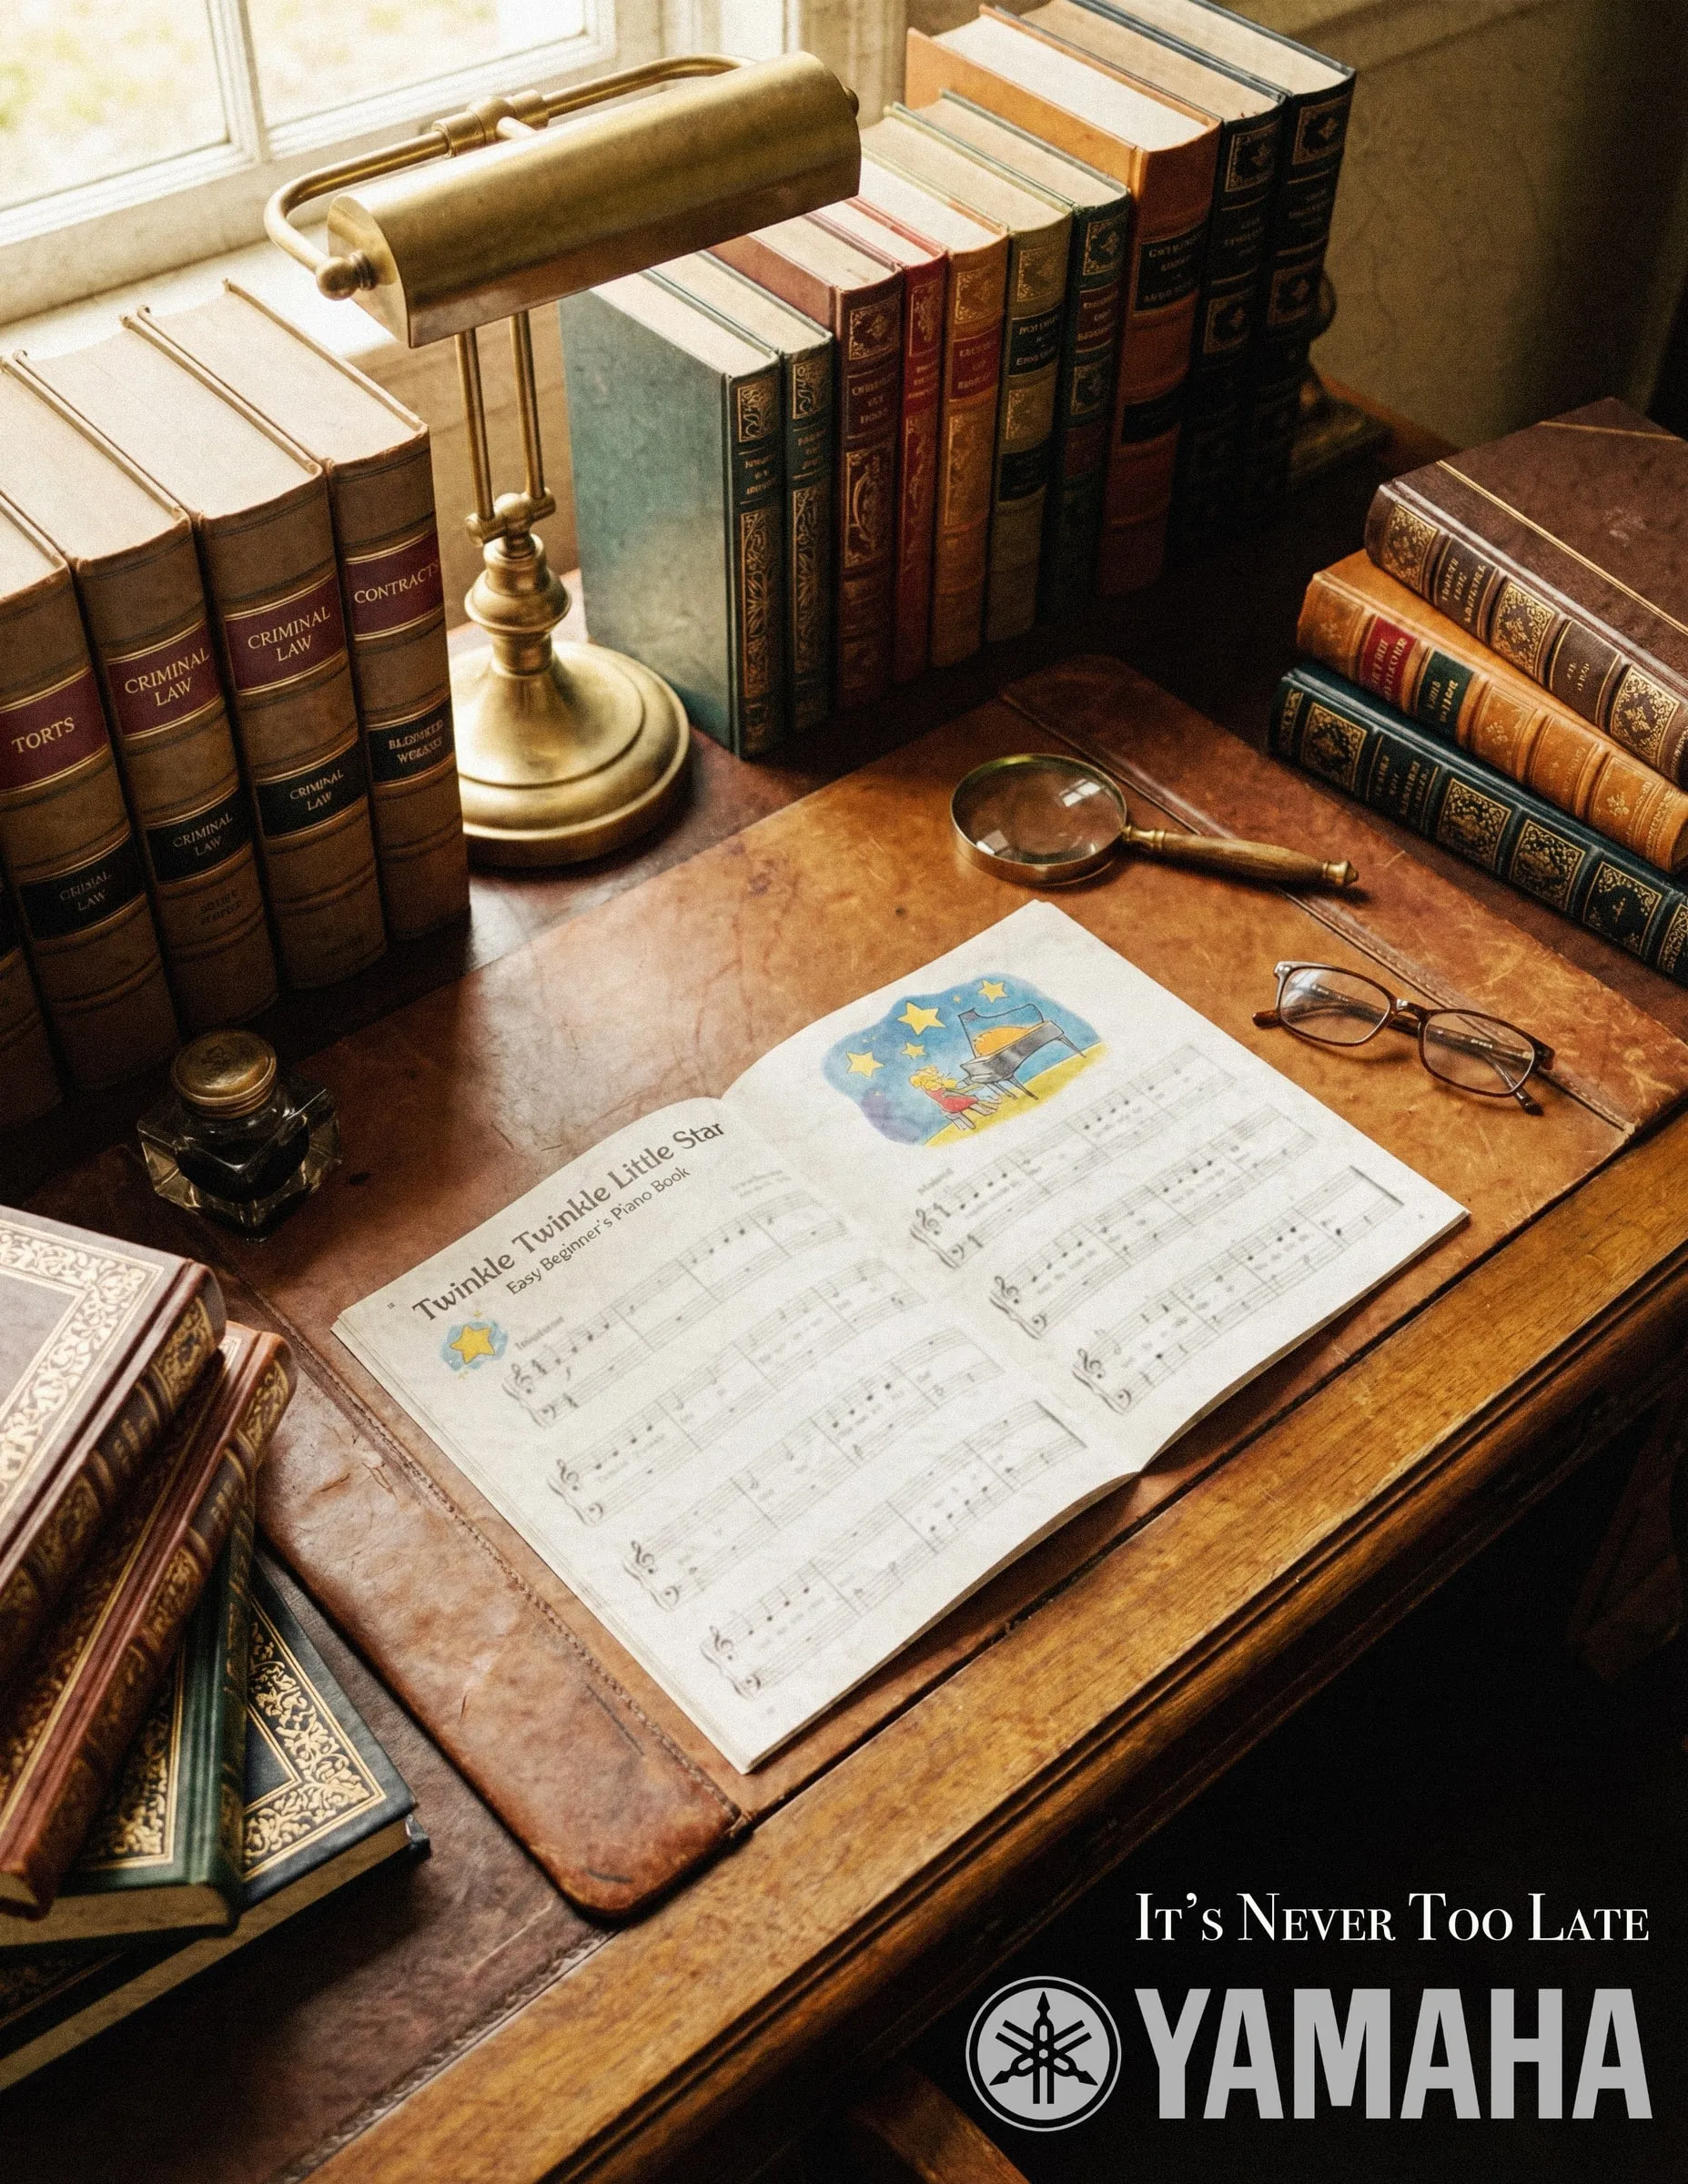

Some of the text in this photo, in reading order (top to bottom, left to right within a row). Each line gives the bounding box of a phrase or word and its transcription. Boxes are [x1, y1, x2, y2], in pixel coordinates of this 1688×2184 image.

[248, 606, 331, 650] CRIMINAL
[276, 634, 311, 662] LAW
[125, 647, 210, 694] CRIMINAL
[154, 676, 192, 707] LAW
[11, 716, 75, 753] TORTS
[289, 769, 344, 800] CRIMINAL
[307, 791, 331, 811] LAW
[173, 813, 233, 847] CRIMINAL
[195, 835, 222, 856] LAW
[411, 1252, 515, 1320] Twinkle
[511, 1186, 611, 1254] Twinkle
[607, 1145, 675, 1190] Little
[672, 1123, 724, 1149] Star
[506, 1167, 691, 1296] Easy Beginner's Piano Book
